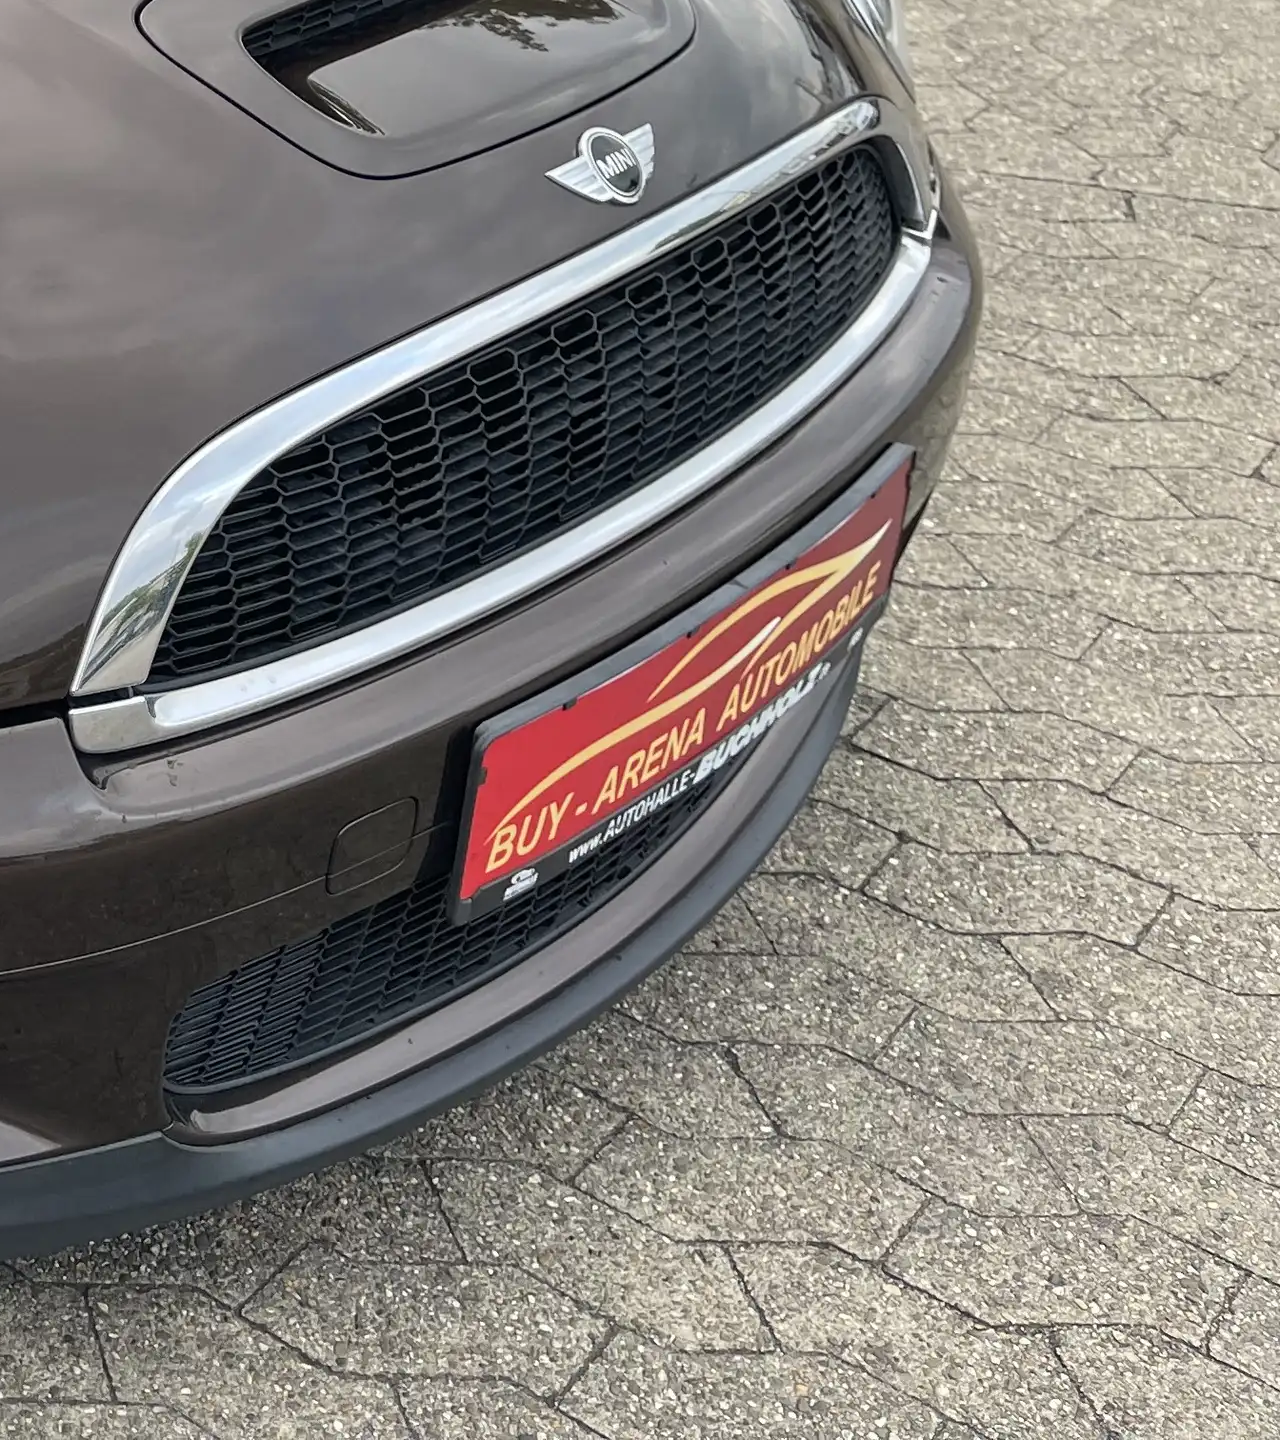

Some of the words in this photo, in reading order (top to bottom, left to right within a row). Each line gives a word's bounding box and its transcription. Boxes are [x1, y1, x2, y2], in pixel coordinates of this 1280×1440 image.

[595, 147, 637, 180] MINI
[484, 791, 573, 874] BUY
[590, 707, 706, 816] ARENA
[715, 560, 882, 732] AUTOMOBILE
